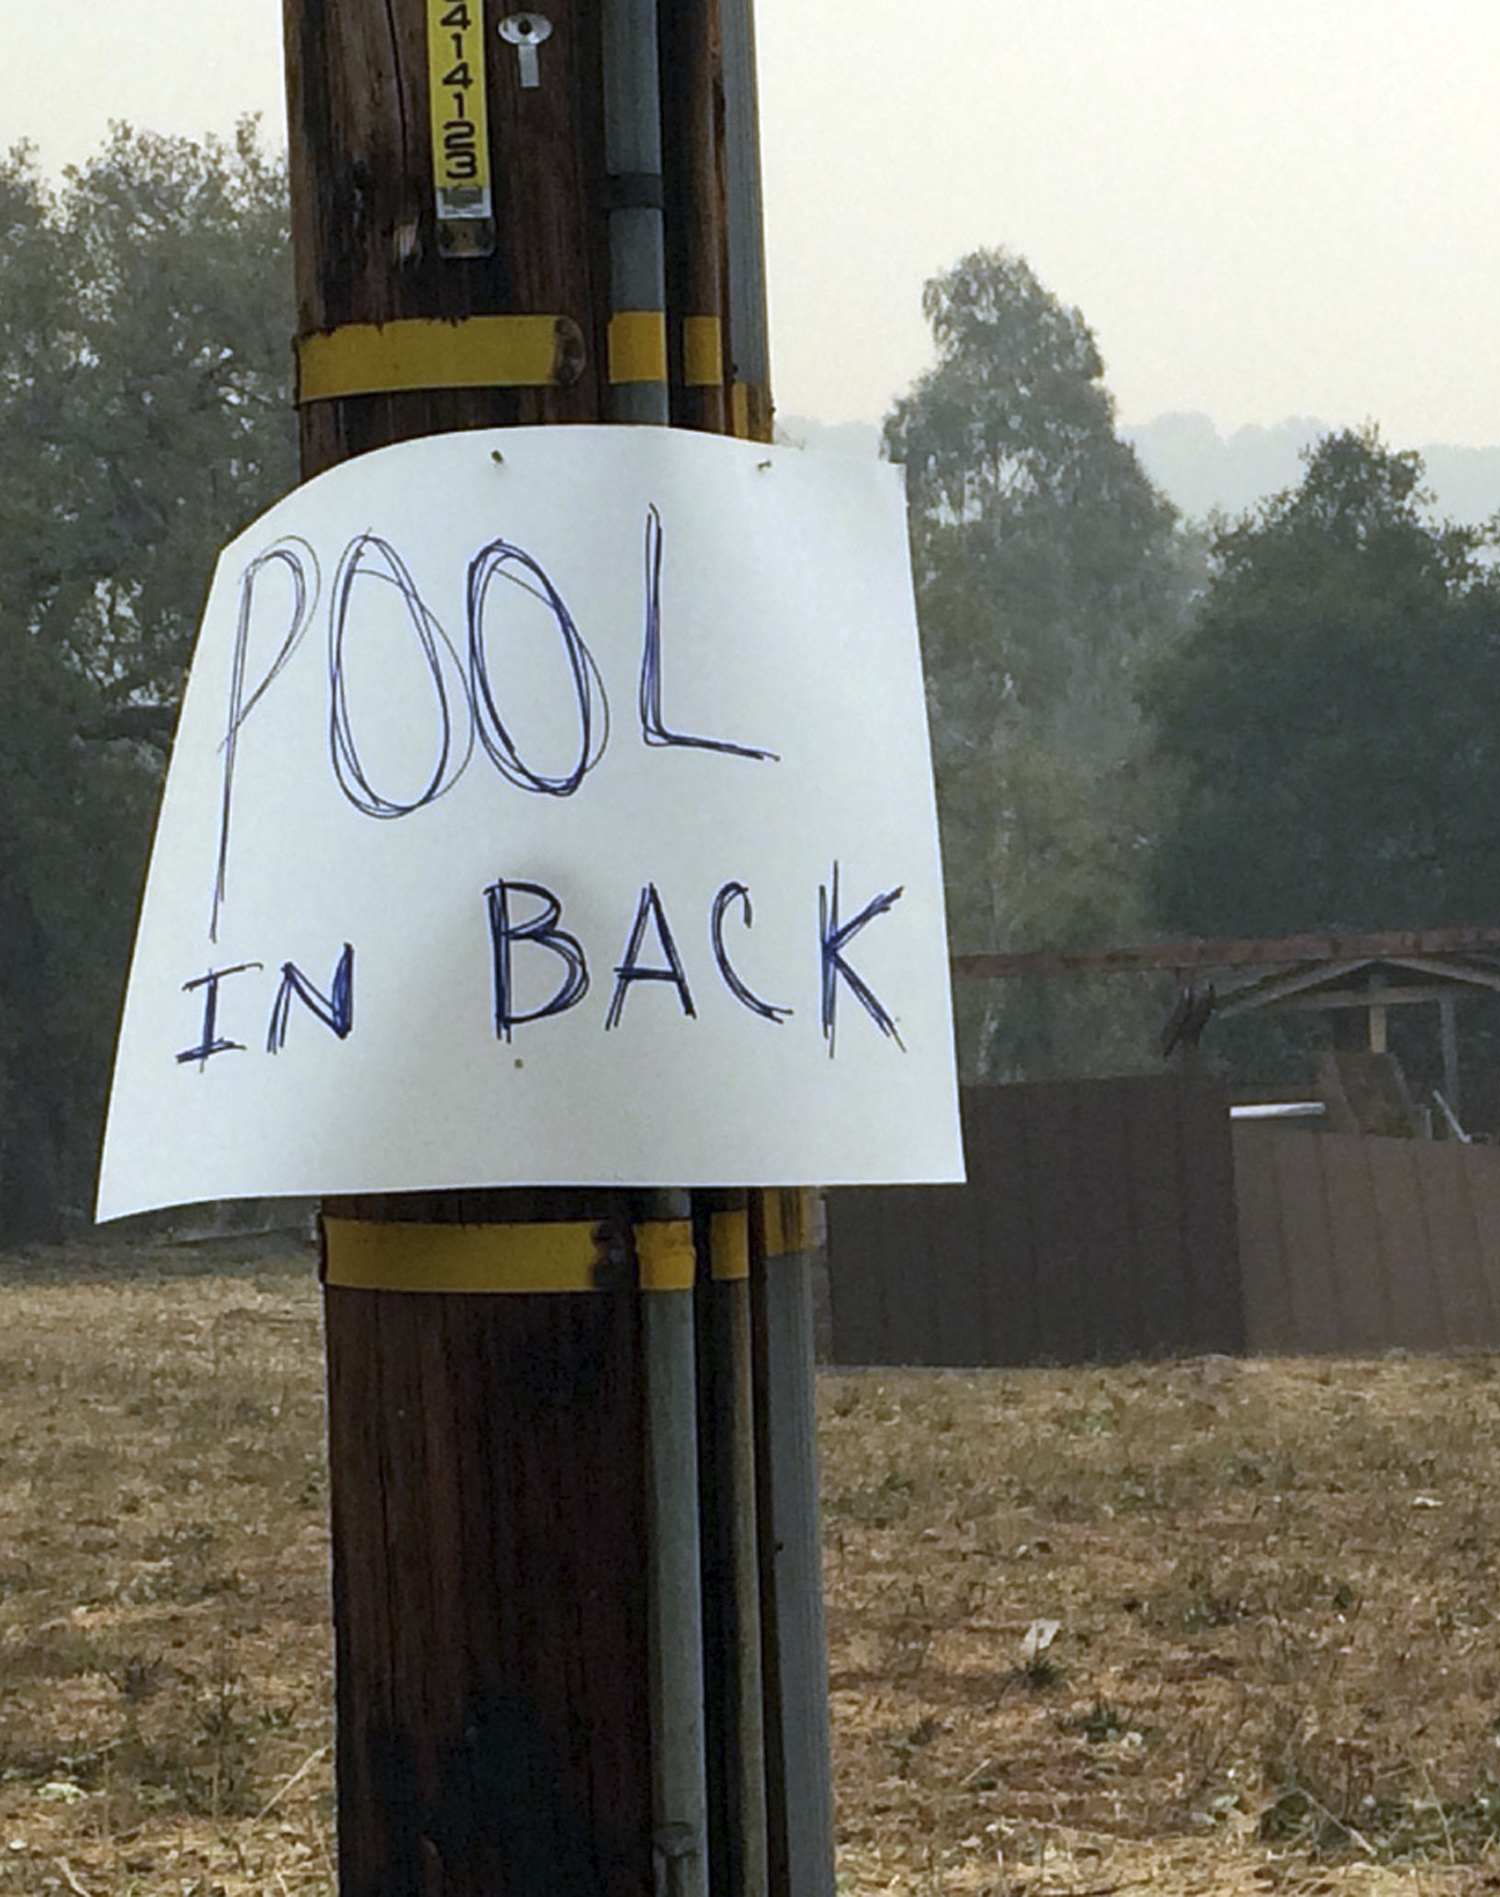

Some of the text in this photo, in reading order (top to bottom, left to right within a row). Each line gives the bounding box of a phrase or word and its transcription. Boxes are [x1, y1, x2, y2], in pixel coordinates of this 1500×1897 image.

[440, 0, 478, 179] 414123
[209, 503, 781, 943] POOL
[175, 859, 906, 1073] IN BACK
